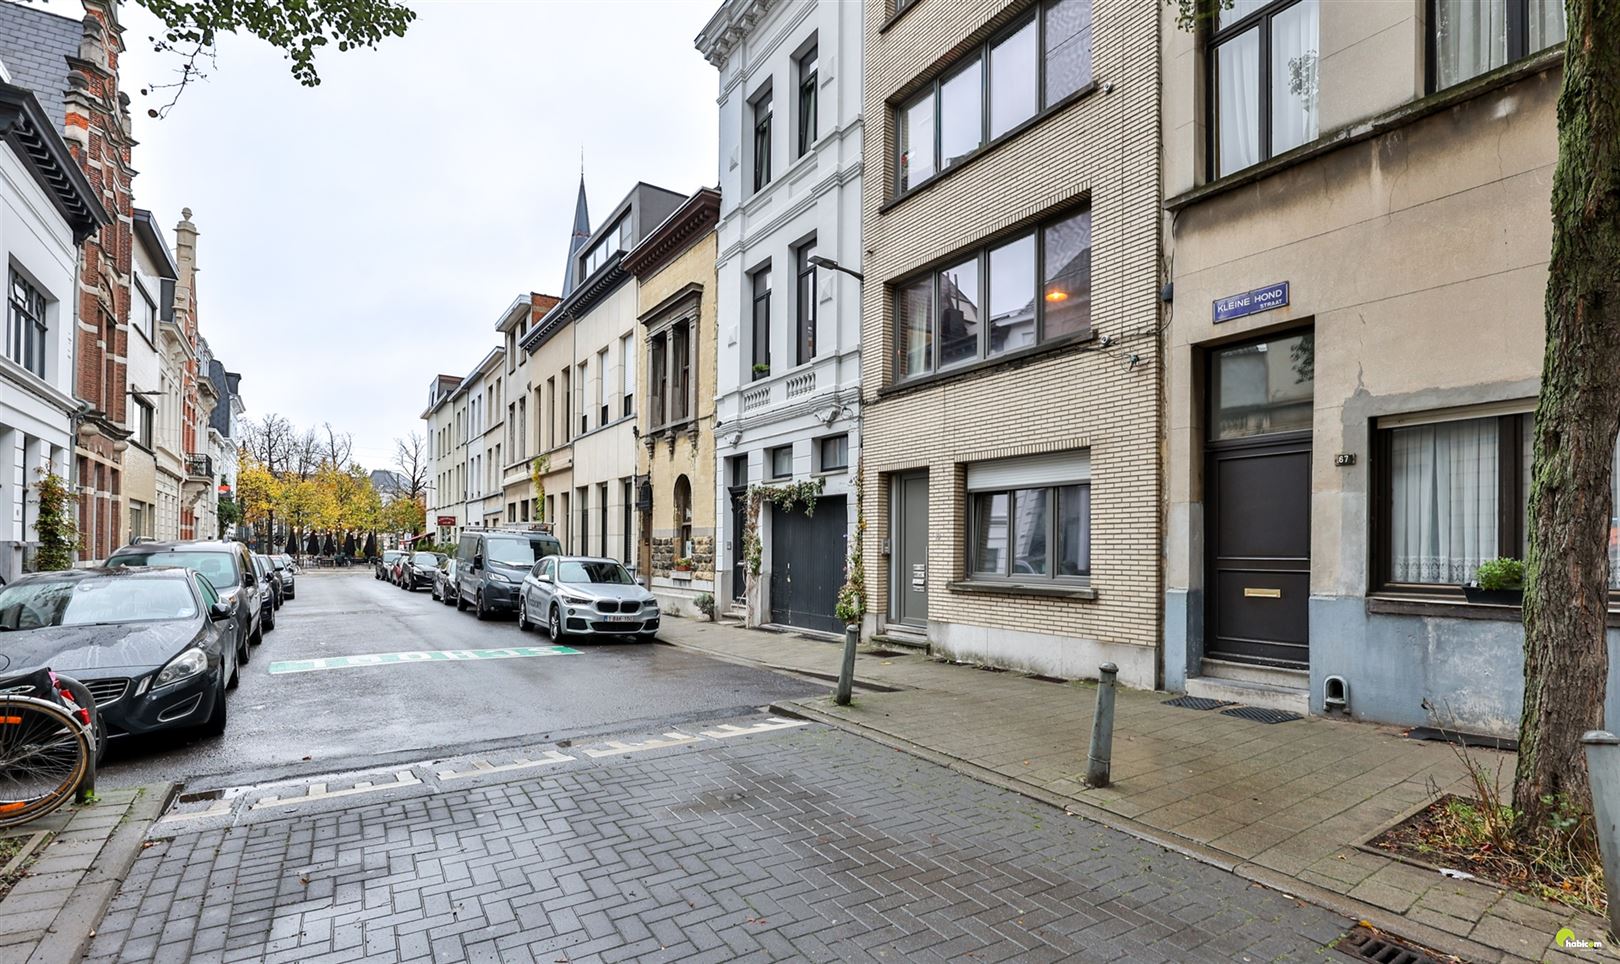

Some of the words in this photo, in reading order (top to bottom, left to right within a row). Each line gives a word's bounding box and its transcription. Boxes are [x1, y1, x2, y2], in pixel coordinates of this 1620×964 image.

[1217, 297, 1251, 313] KLEINE
[1254, 289, 1283, 303] HOND
[1259, 298, 1283, 309] STRAAT
[1338, 454, 1349, 463] 67
